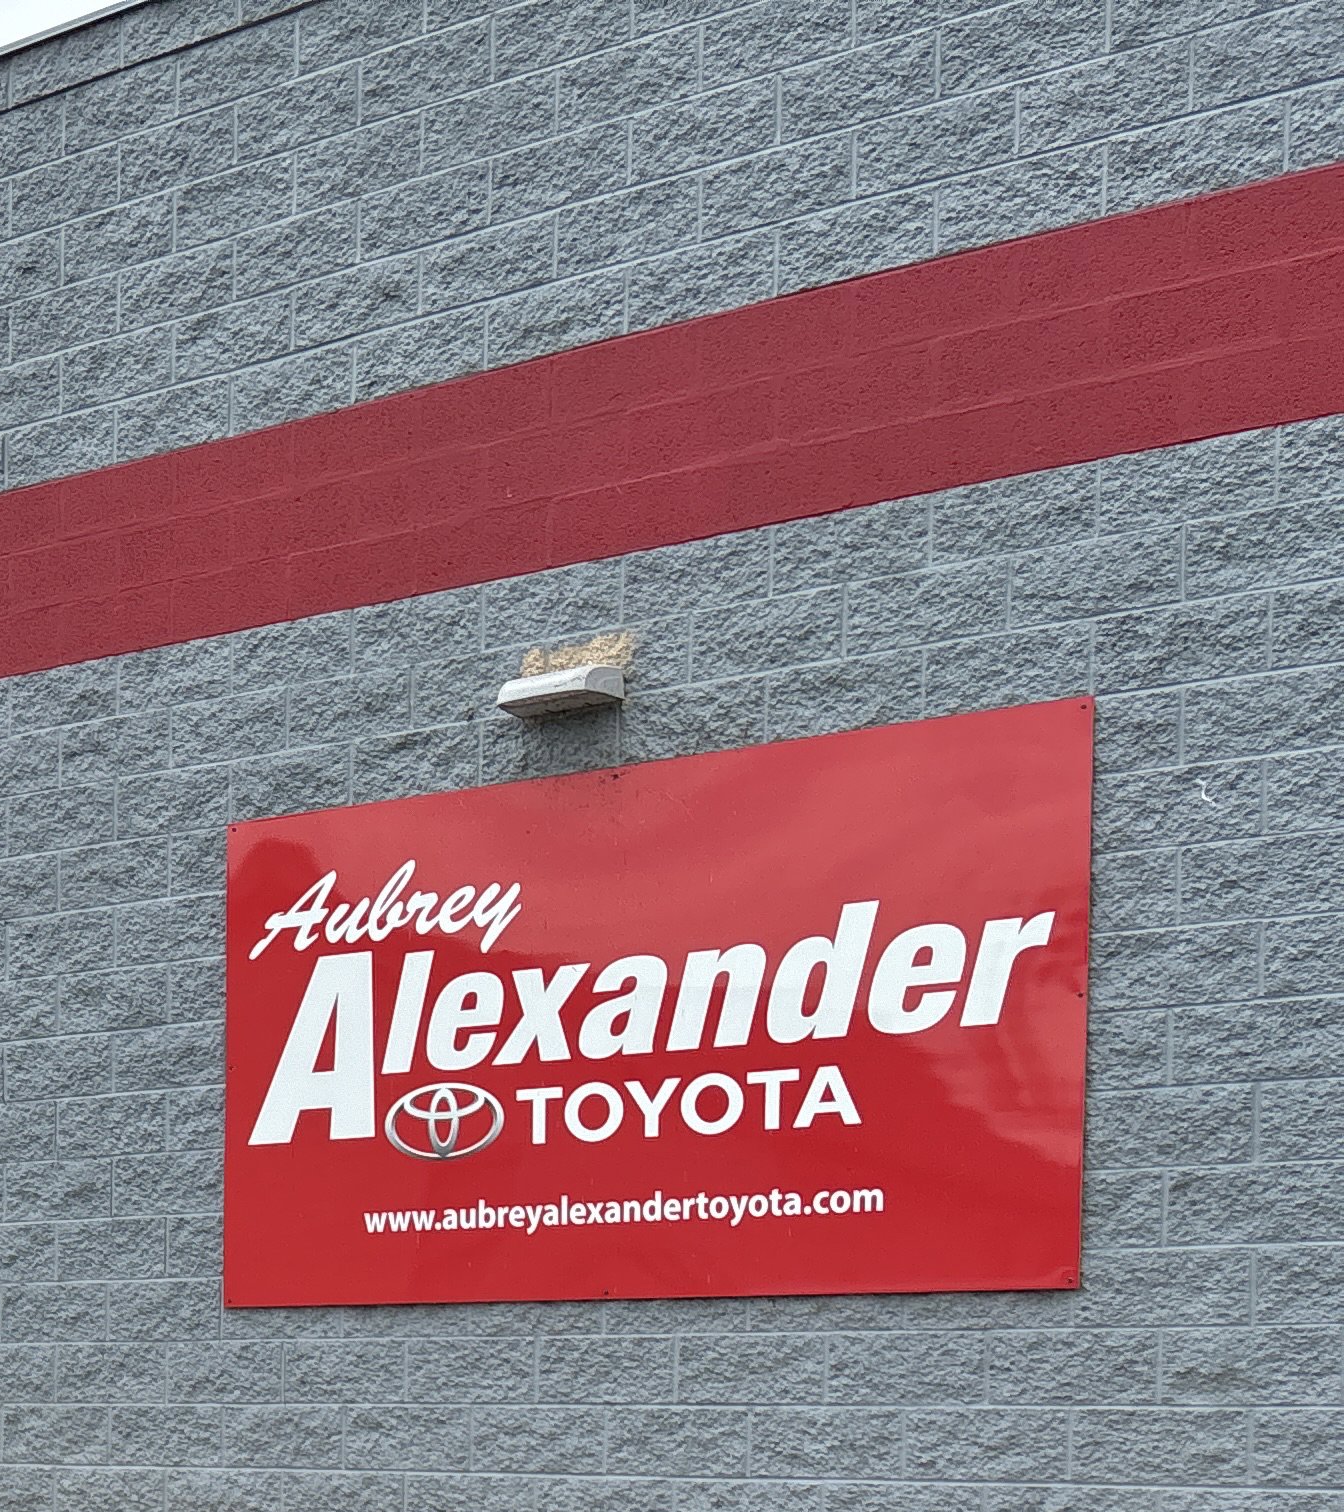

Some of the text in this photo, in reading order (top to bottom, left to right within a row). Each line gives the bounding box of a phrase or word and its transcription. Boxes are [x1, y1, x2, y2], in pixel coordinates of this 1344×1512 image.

[248, 859, 522, 961] Aubrey
[247, 899, 1056, 1146] Alexander
[515, 1065, 862, 1145] TOYOTA
[363, 1188, 884, 1235] www.aubreyalexandertoyota.com
